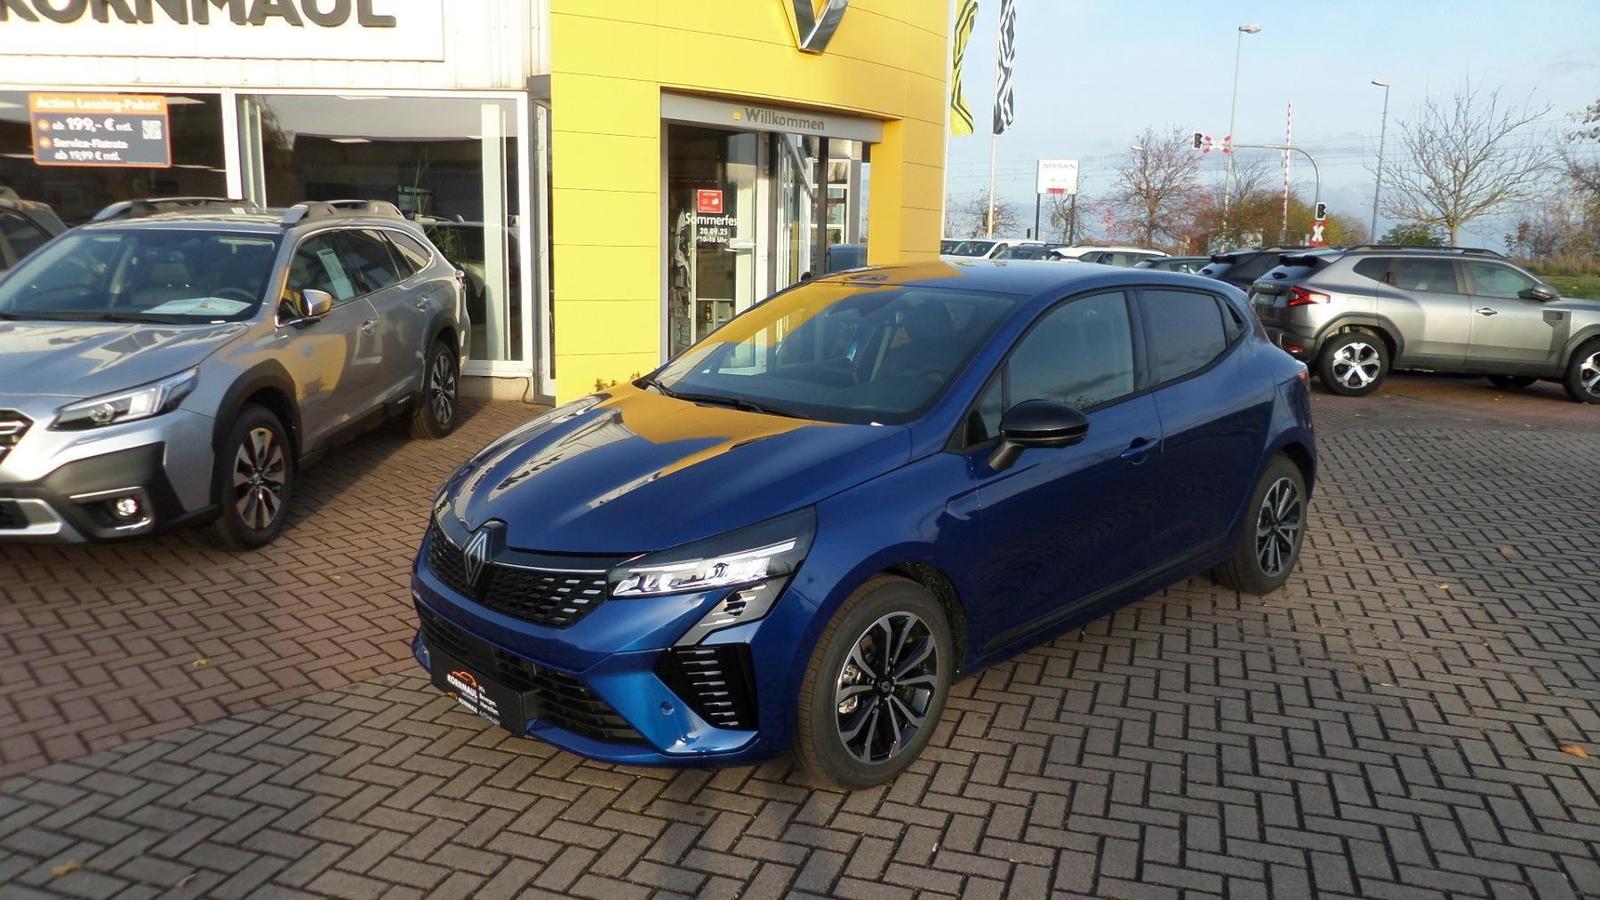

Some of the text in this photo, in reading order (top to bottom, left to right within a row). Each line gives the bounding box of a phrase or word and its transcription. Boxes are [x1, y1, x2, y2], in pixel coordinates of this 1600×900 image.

[52, 121, 65, 130] ab
[103, 117, 115, 132] €
[744, 106, 825, 131] Willkommen
[52, 137, 128, 149] Service-Flatrate
[54, 150, 68, 160] ab
[94, 151, 103, 161] €
[685, 212, 739, 226] Sommerfes
